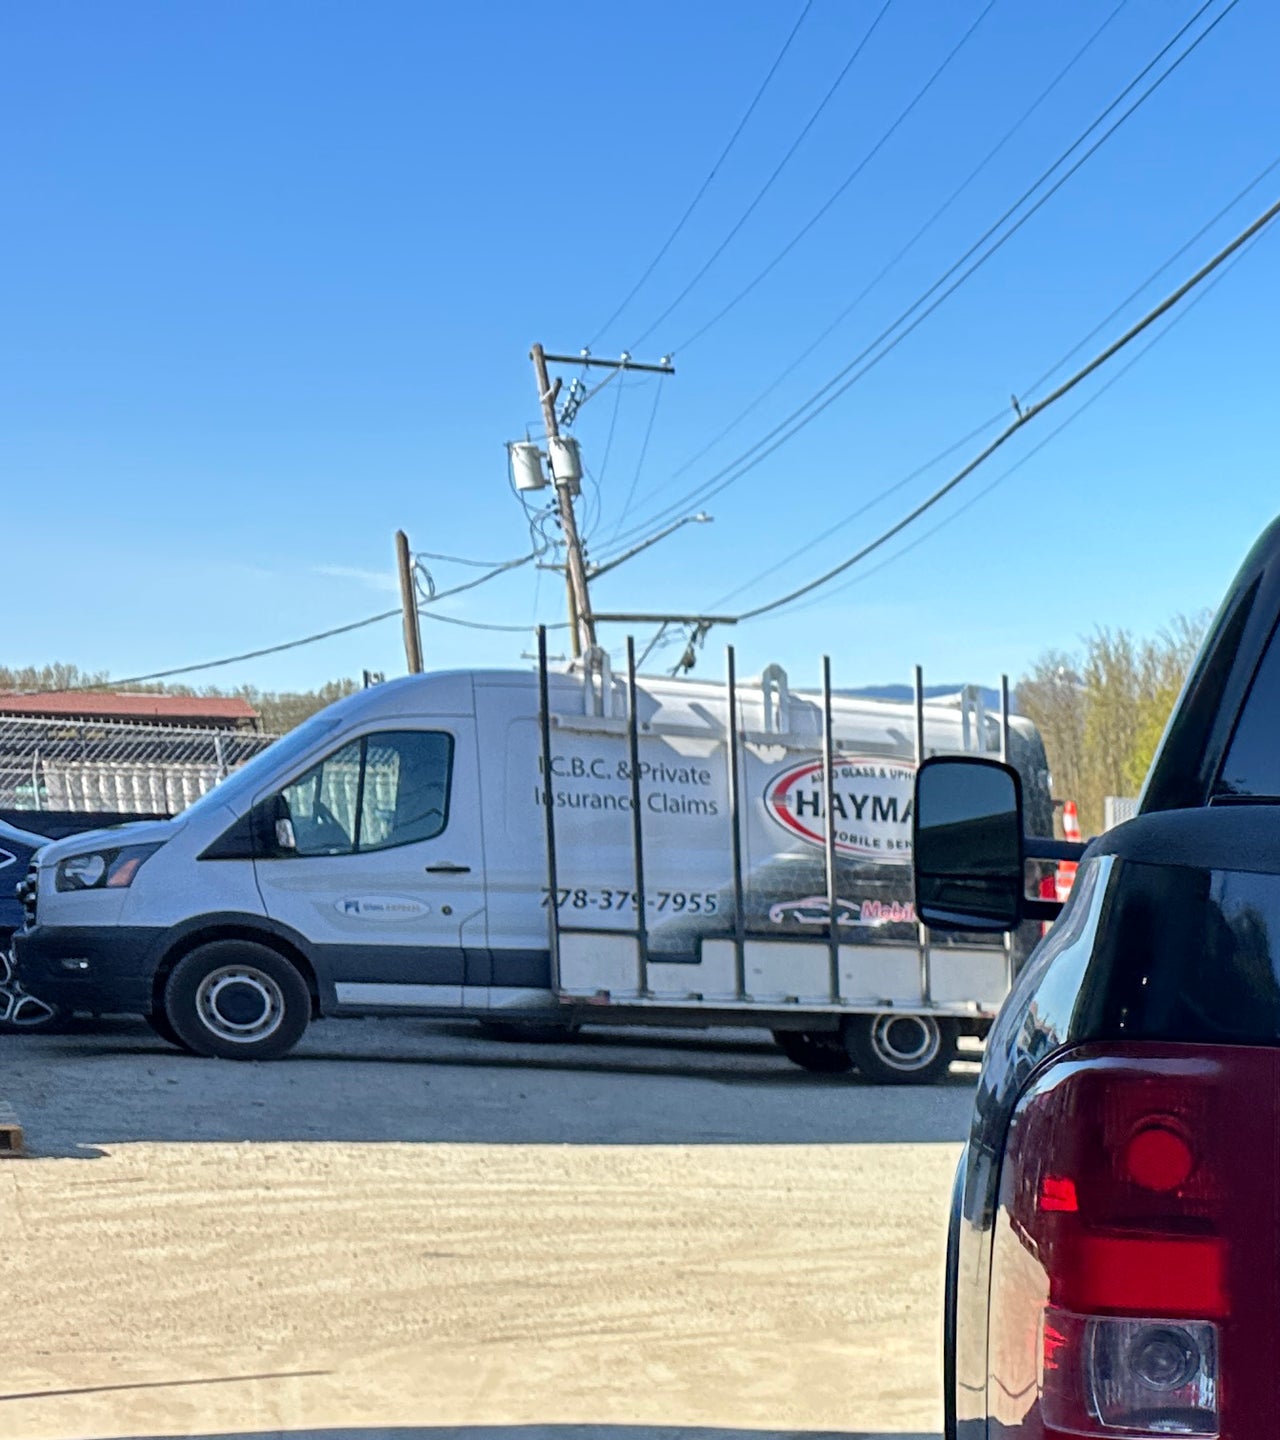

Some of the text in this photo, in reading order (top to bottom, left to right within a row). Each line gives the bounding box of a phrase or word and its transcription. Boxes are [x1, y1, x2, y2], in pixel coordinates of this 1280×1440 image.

[538, 755, 712, 786] IC.B.C. & Private
[841, 766, 876, 779] GLASS
[879, 766, 887, 779] &
[890, 768, 915, 781] UPH
[534, 786, 719, 816] Isuranc Claims
